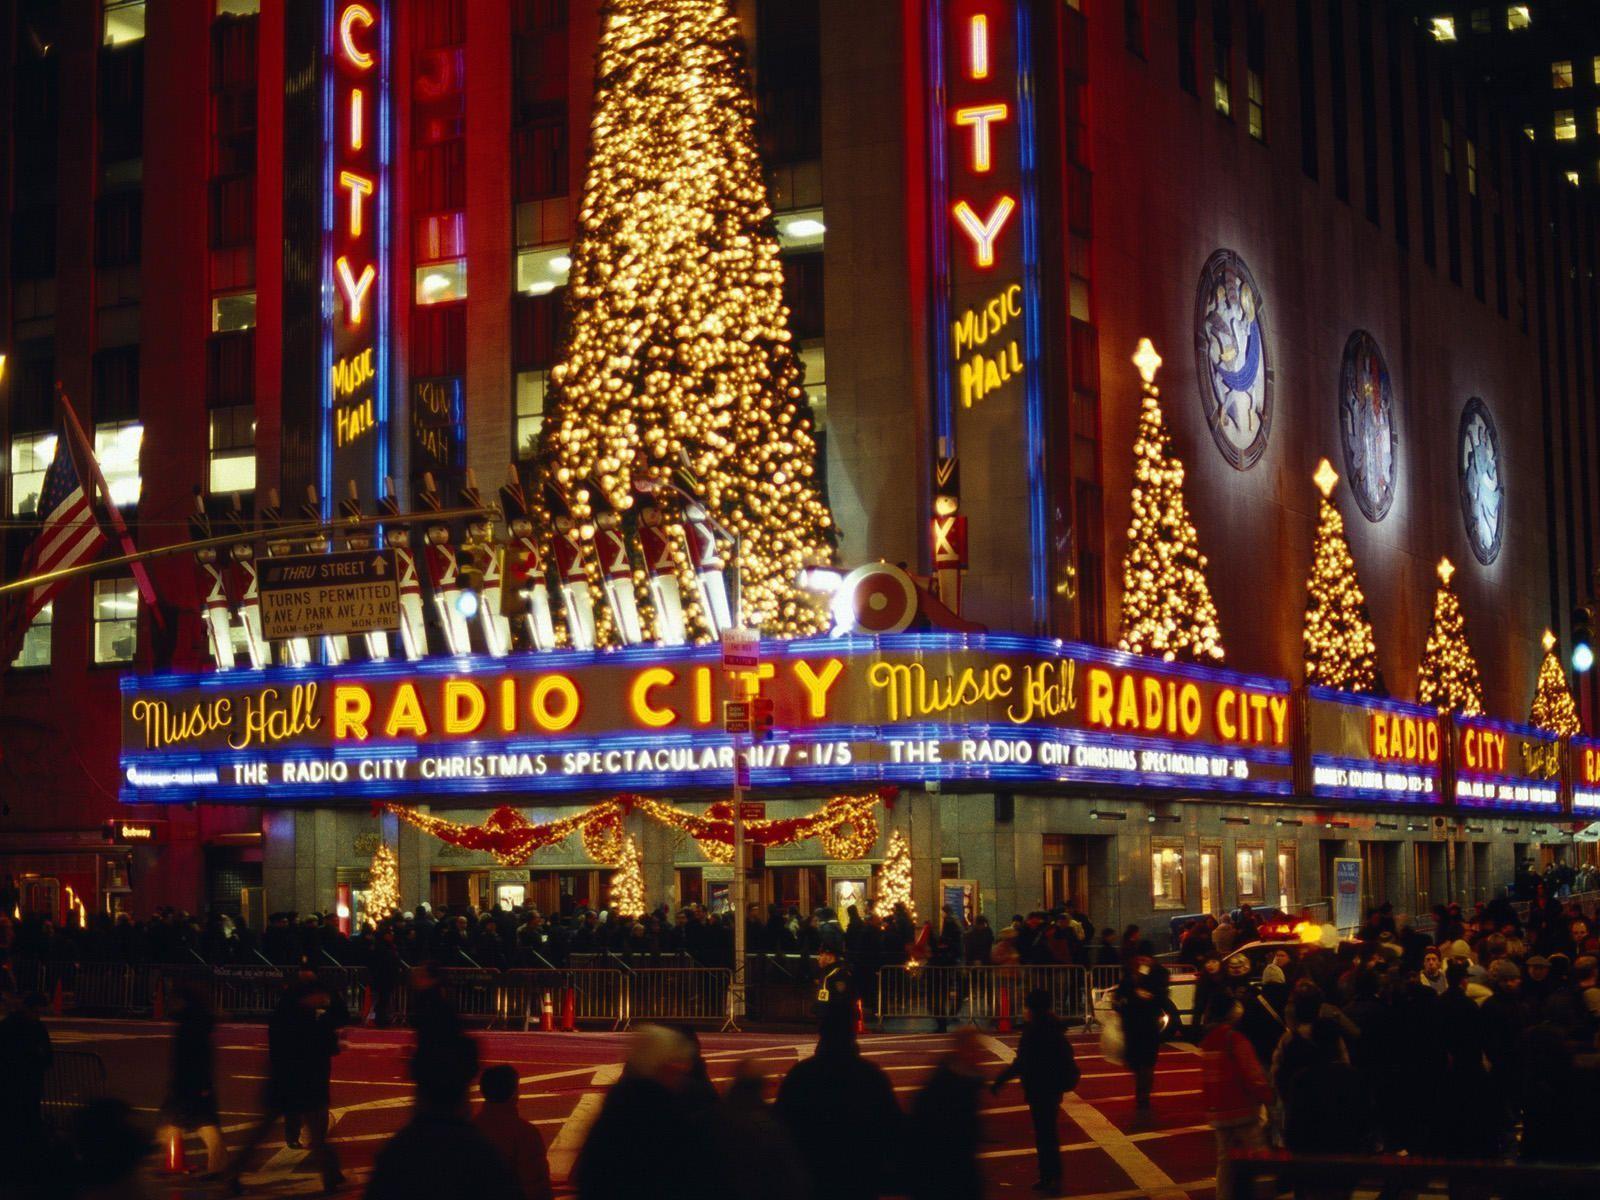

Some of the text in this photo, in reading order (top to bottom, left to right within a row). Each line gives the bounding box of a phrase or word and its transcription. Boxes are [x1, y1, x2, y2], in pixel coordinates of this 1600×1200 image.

[336, 4, 375, 323] CITY
[953, 285, 1023, 359] MUSIC
[332, 348, 374, 401] MUSIC
[959, 341, 1024, 407] HALL
[337, 399, 374, 447] HALL
[268, 585, 391, 607] TURNS PERMITTED
[282, 561, 366, 580] THRU STREET
[274, 609, 292, 623] AVE
[305, 606, 333, 621] PARK
[337, 604, 355, 617] AVE
[368, 603, 374, 615] 3
[378, 601, 397, 614] AVE
[132, 682, 320, 749] Music Hall
[335, 675, 580, 740] RADIO
[870, 658, 1077, 724] Music Hall
[1089, 669, 1287, 743] RADIO CITY
[233, 762, 269, 784] THE
[282, 760, 347, 783] RADIO
[359, 758, 407, 780] CITY
[421, 754, 547, 778] CHRISTMAS
[564, 747, 733, 774] SPECTACULAR
[815, 742, 852, 765] 1/5
[890, 740, 941, 763] THE
[961, 740, 1033, 763] RADIO
[1041, 742, 1070, 764] CITY
[1076, 745, 1137, 770] CHRISTMAS
[1141, 752, 1209, 775] SPECTACULAR
[1374, 715, 1439, 761] RADIO
[1465, 728, 1505, 770] CITY
